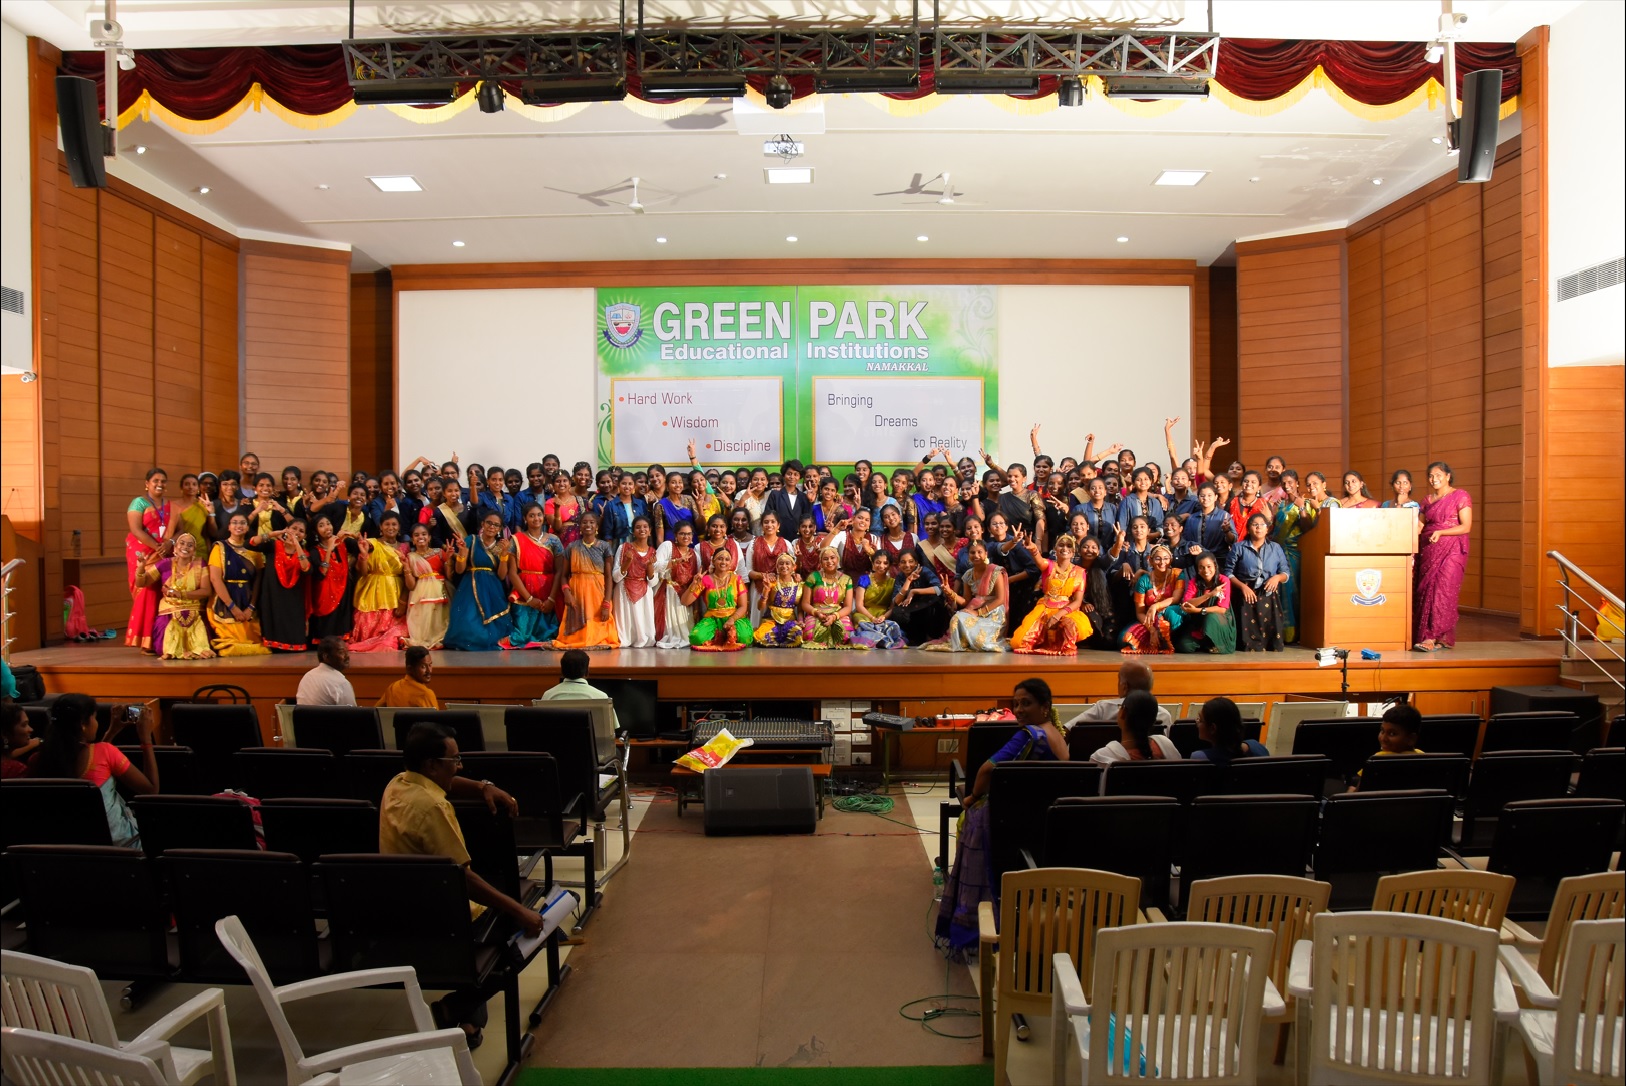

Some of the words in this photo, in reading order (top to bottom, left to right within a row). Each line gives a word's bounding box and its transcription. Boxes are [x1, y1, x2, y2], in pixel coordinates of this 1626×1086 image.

[652, 300, 792, 342] GREEN
[808, 300, 930, 340] PARK
[660, 342, 789, 361] Educational
[806, 341, 930, 360] Institutions
[866, 362, 929, 372] NAMAKKAL
[627, 392, 657, 405] Hard
[661, 392, 693, 405] Work
[827, 393, 873, 409] Bringing
[670, 415, 719, 429] Wisdom
[874, 414, 918, 428] Dreams
[713, 439, 771, 455] Discipline
[913, 437, 926, 449] to
[929, 436, 968, 452] Reality
